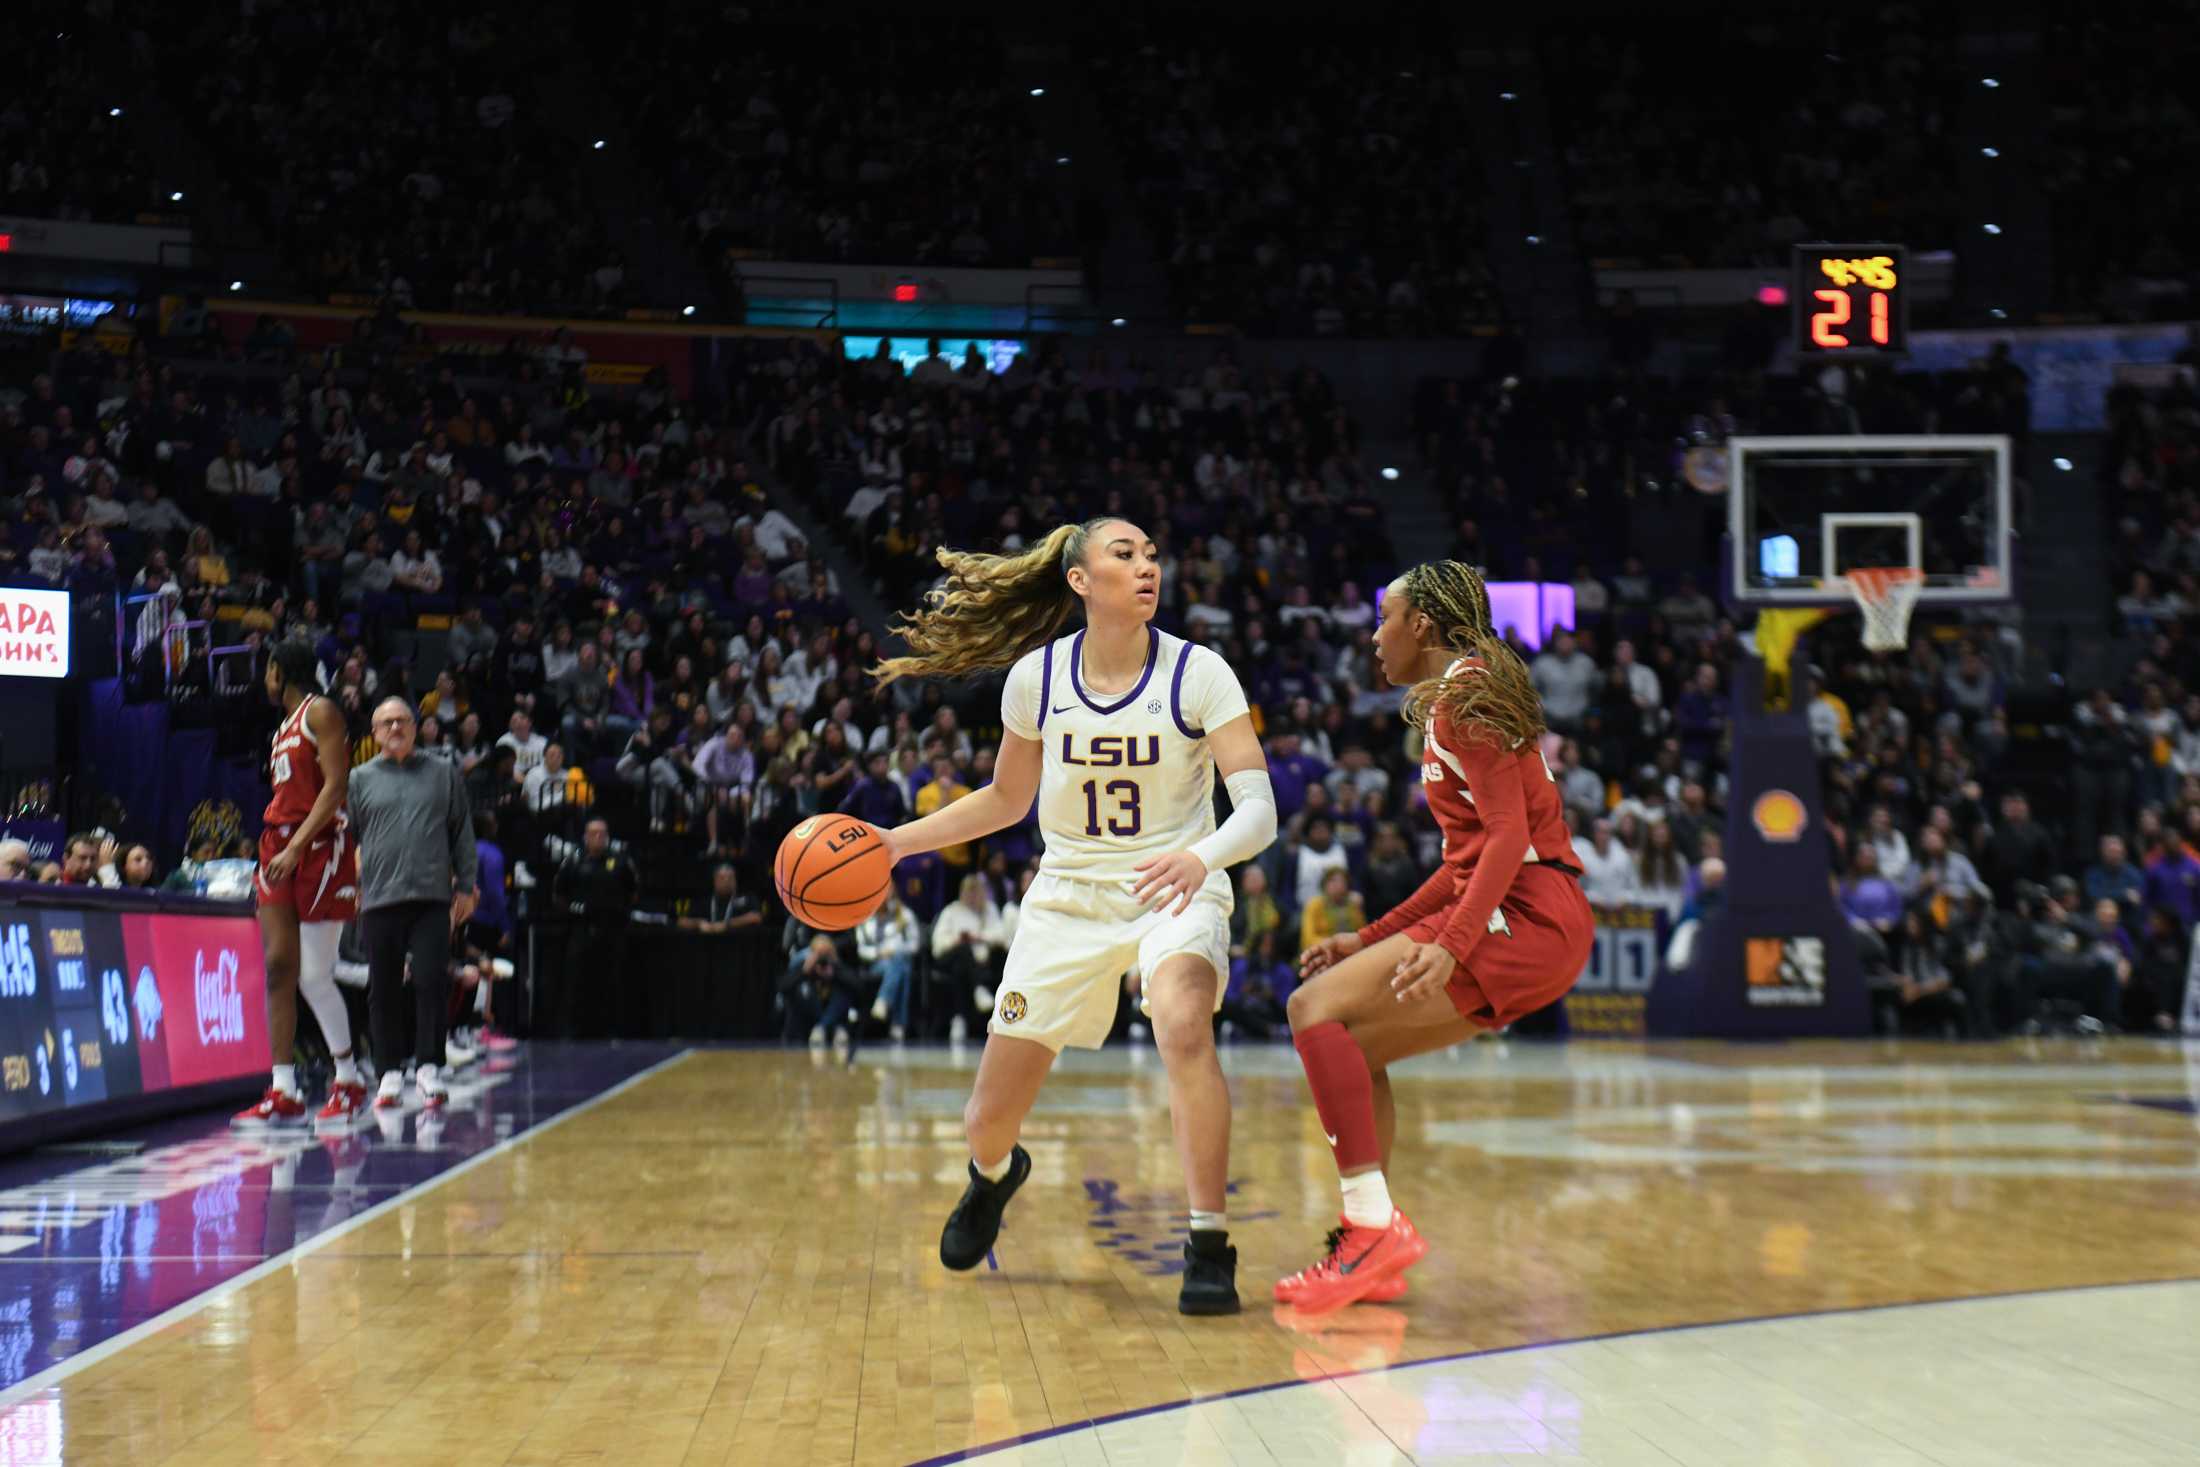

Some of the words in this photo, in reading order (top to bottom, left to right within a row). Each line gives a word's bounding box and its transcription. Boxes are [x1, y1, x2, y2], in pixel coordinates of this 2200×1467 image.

[1821, 256, 1897, 289] 4:45
[1811, 289, 1889, 347] 21
[0, 641, 58, 663] HNS
[1061, 732, 1161, 767] LSU
[1082, 778, 1142, 837] 13
[827, 825, 868, 853] LSU
[101, 968, 129, 1045] 43
